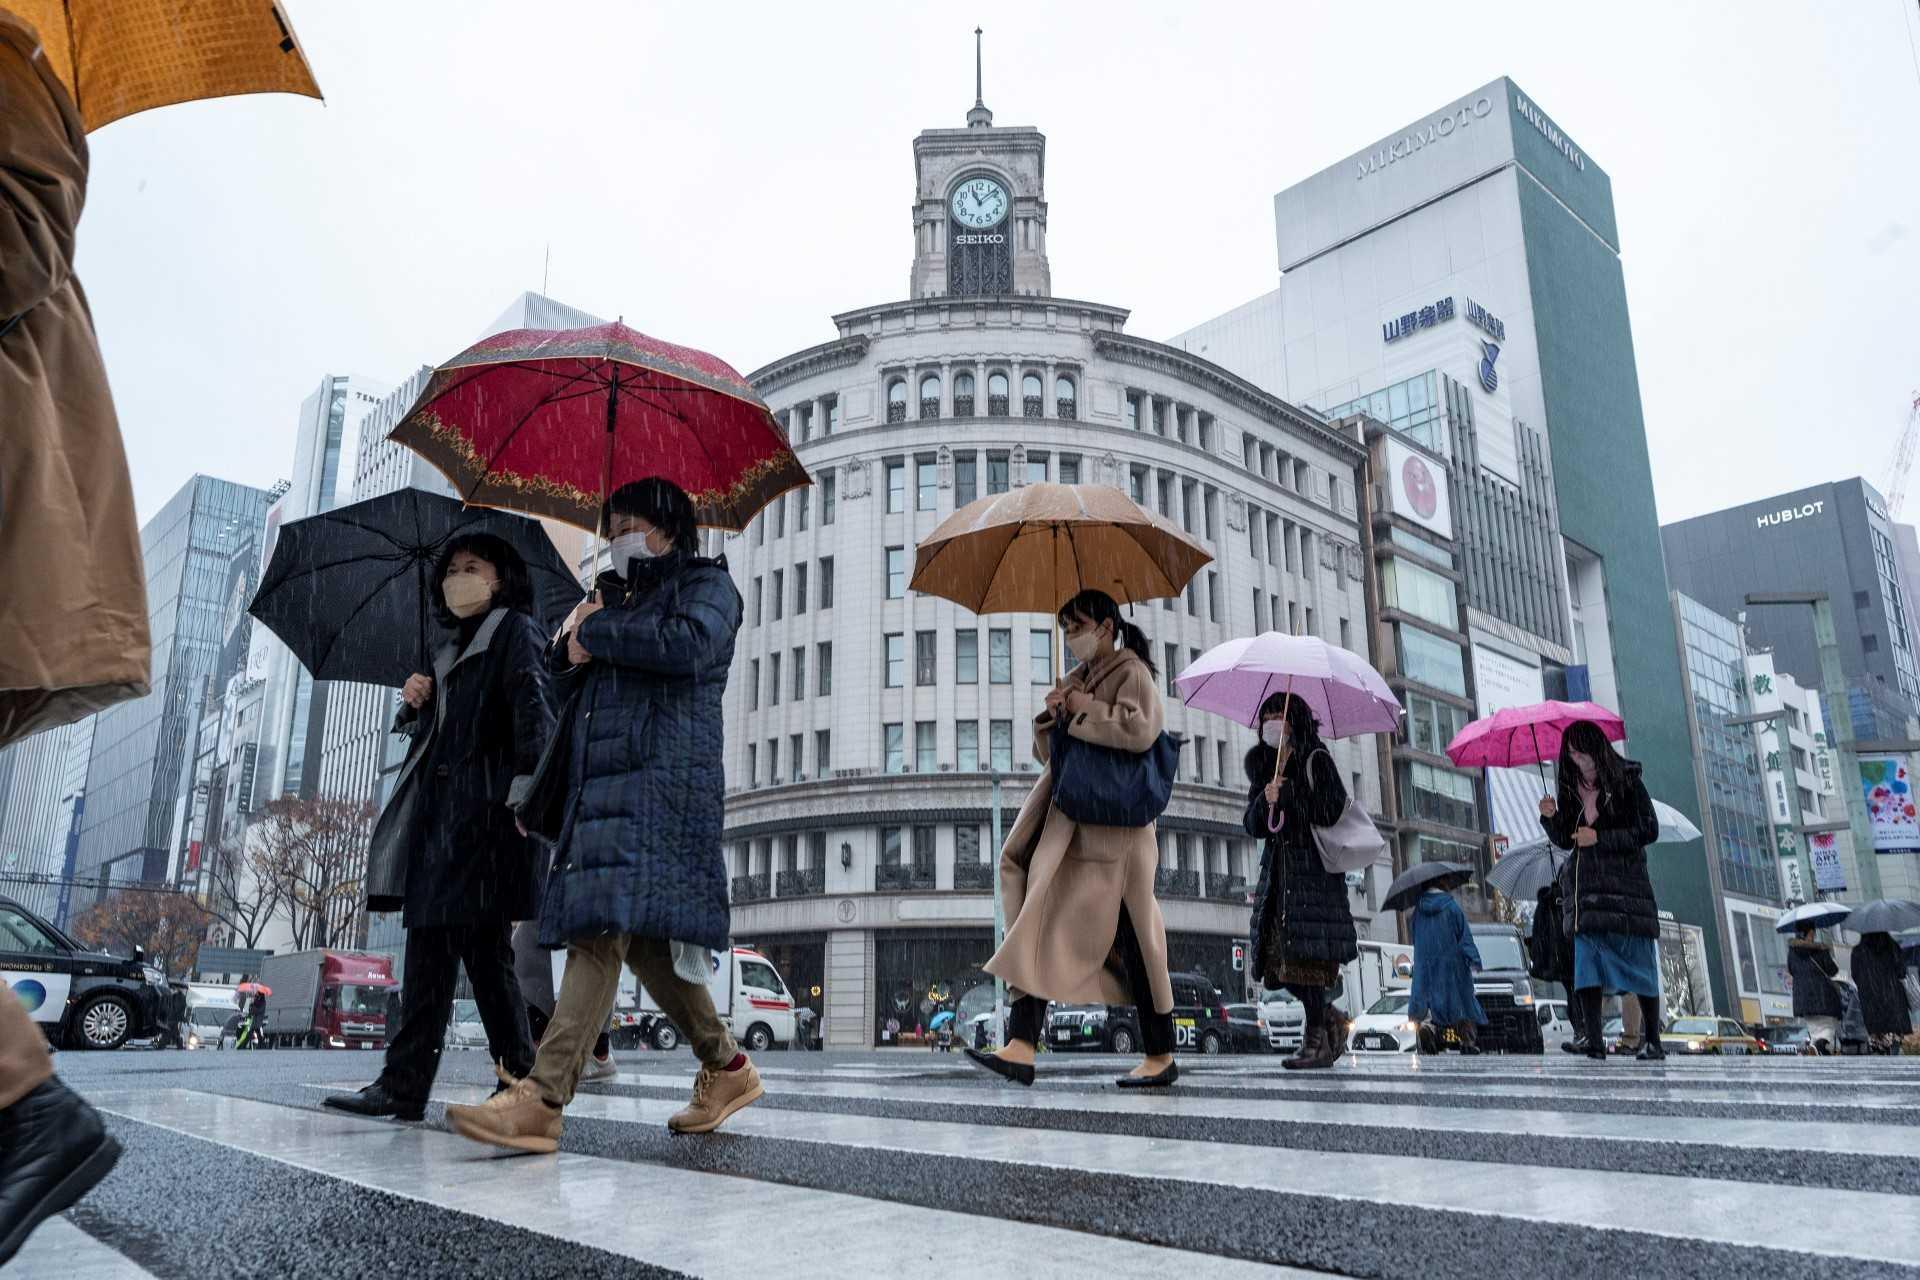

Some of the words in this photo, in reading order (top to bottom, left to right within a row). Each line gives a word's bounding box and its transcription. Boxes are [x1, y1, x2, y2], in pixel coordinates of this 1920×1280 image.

[1516, 94, 1585, 171] MIKIMOTO
[1356, 97, 1494, 181] MIKIMOTO
[976, 182, 984, 191] 12
[960, 191, 968, 200] 10
[956, 200, 964, 208] 9
[960, 207, 967, 217] 8
[985, 212, 992, 222] 5
[967, 213, 975, 222] 7
[976, 216, 983, 224] 6
[956, 233, 1004, 245] SEIKO
[1756, 501, 1824, 529] HUBLOT
[1777, 828, 1797, 852] 本
